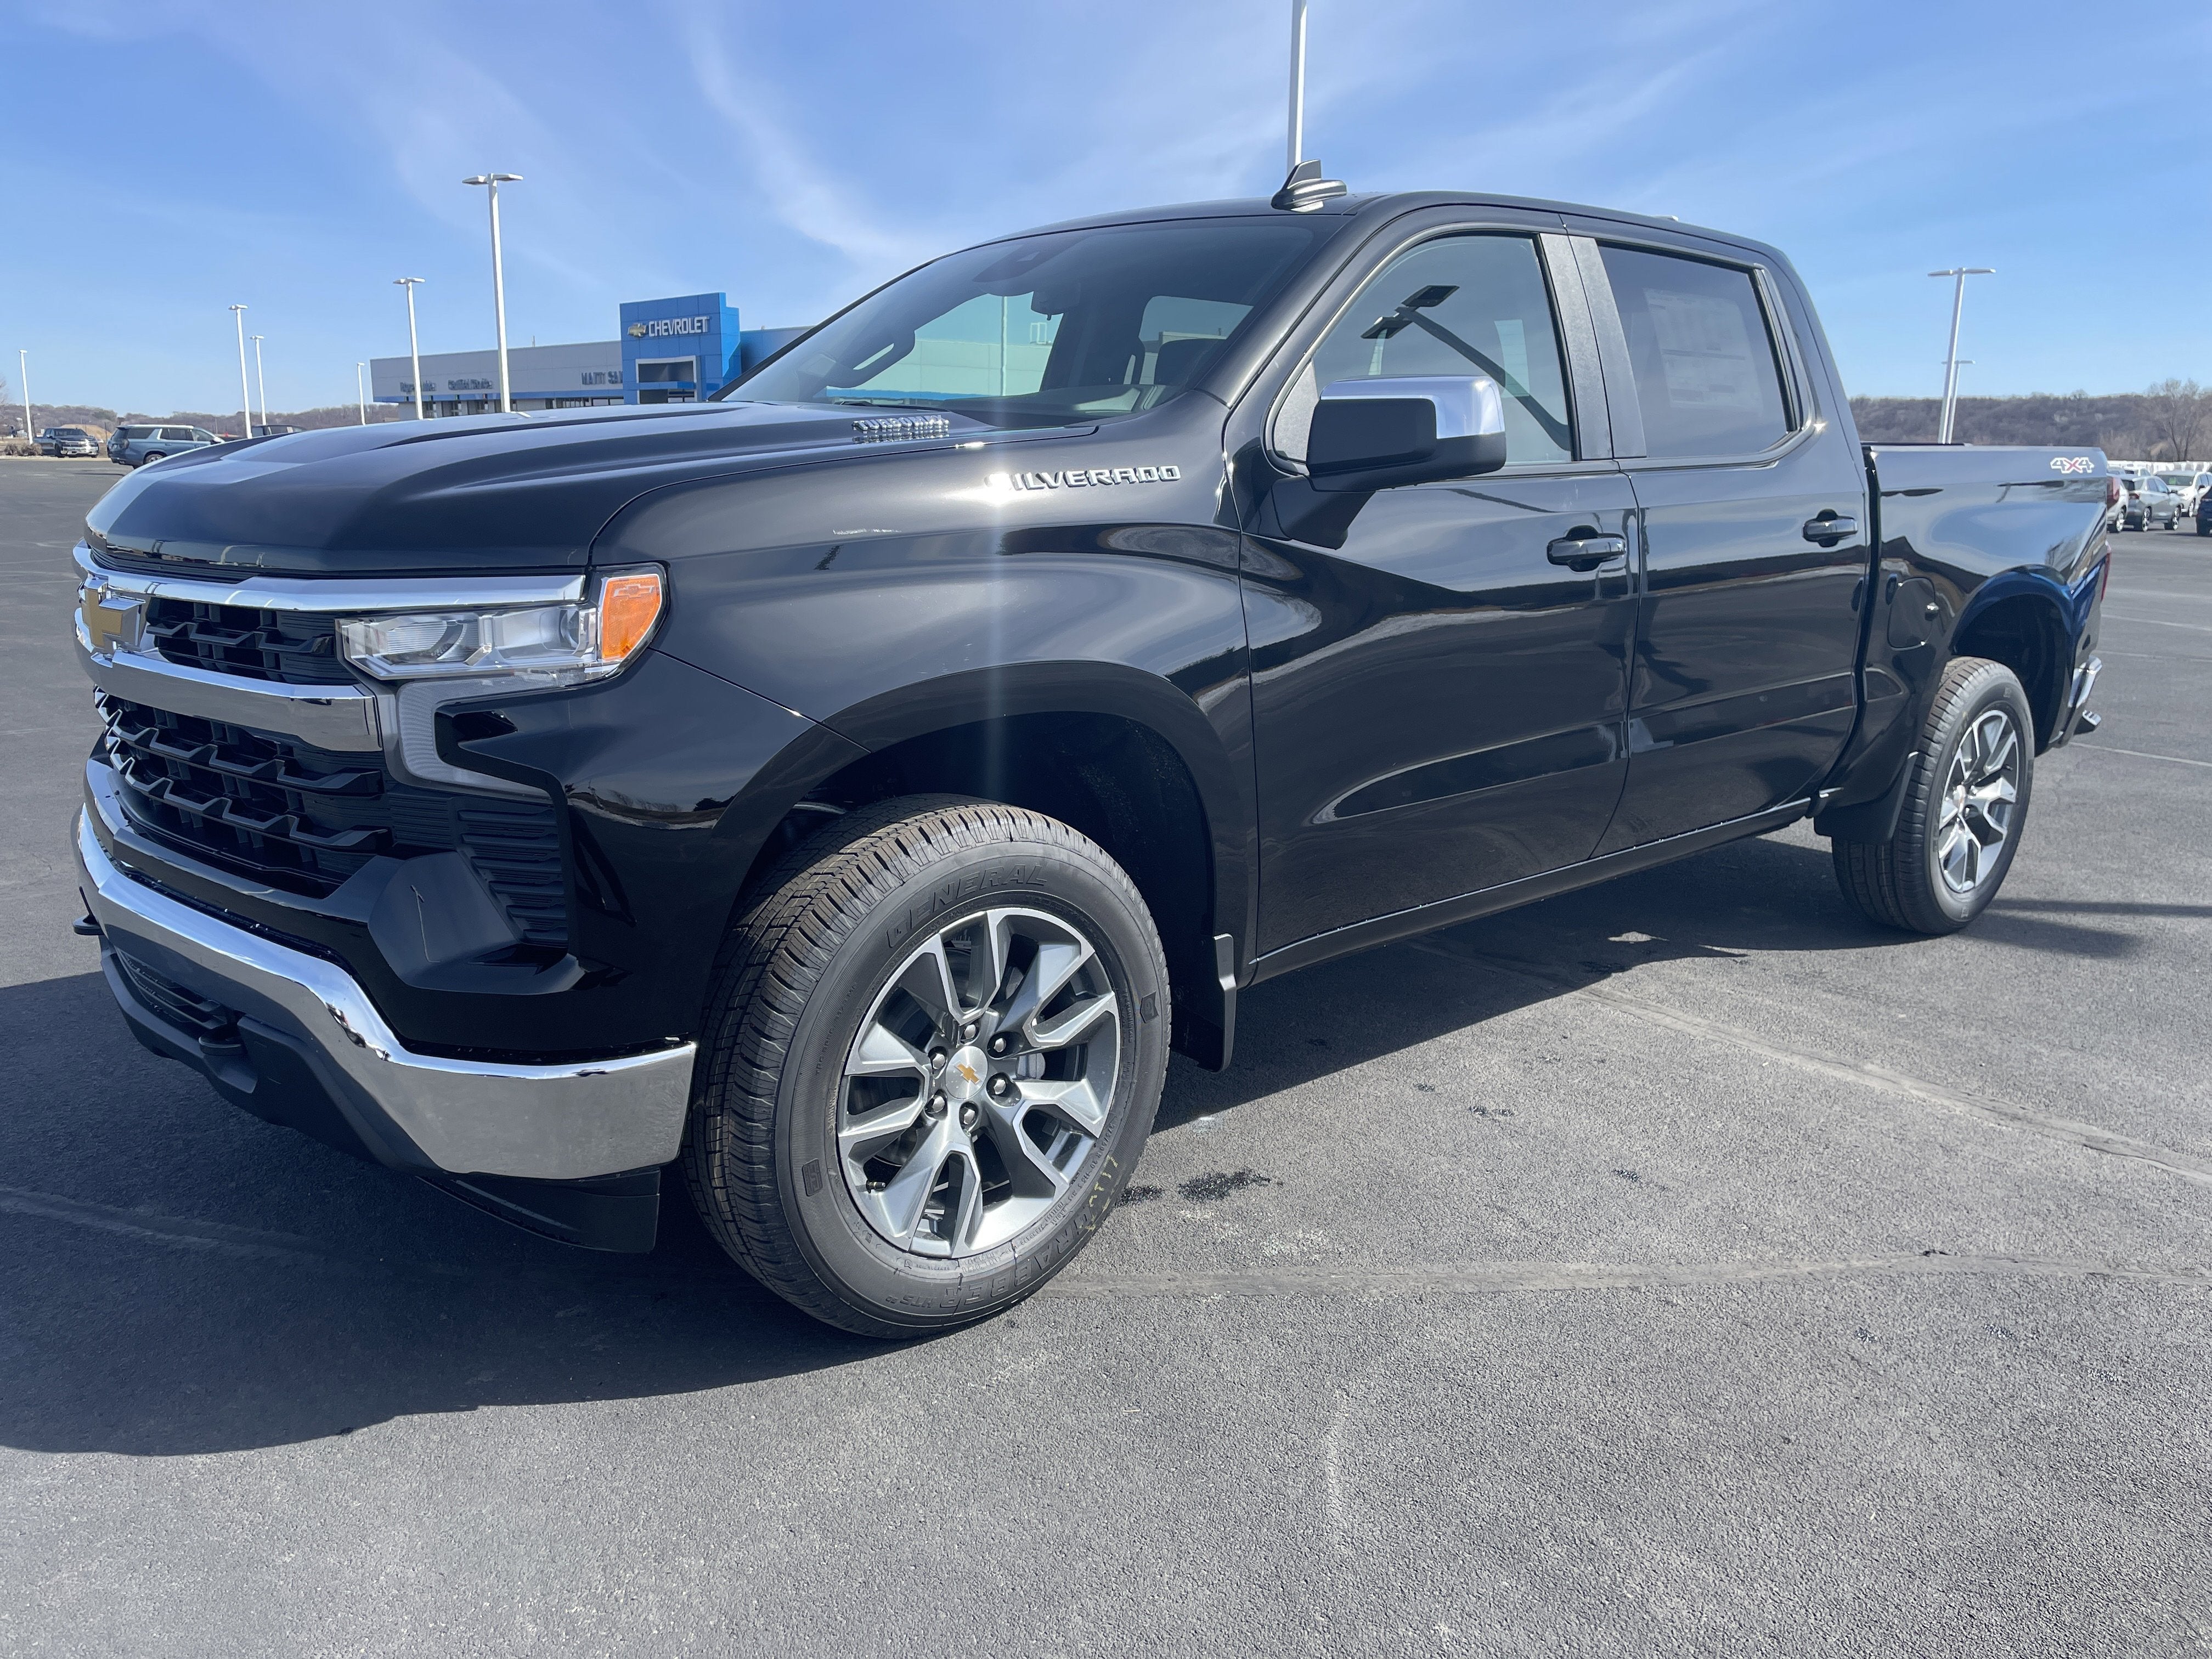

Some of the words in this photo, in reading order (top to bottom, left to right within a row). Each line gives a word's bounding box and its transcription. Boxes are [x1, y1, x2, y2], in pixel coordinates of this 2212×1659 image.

[648, 316, 709, 337] CHEVROLET
[2050, 456, 2095, 474] 4X4
[887, 863, 1048, 949] GENERAL
[939, 1205, 1093, 1308] GRABBER
